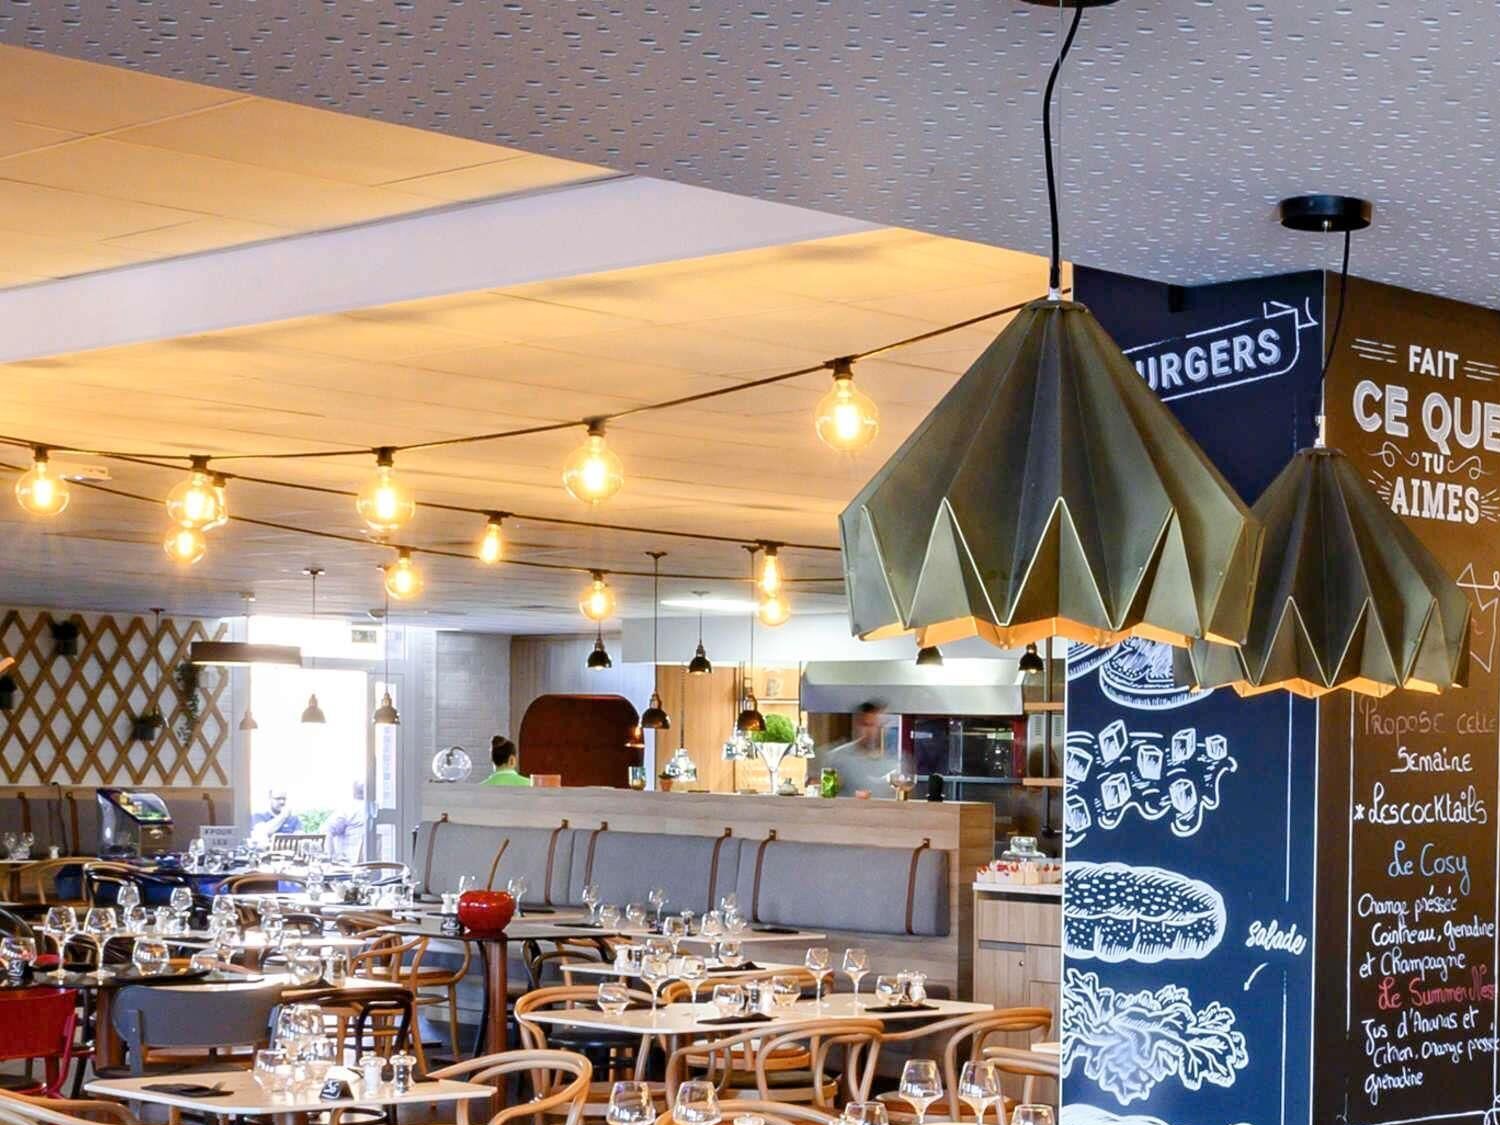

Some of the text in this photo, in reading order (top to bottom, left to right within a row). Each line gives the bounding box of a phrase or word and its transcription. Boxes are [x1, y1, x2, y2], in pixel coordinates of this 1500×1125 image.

[1136, 328, 1281, 391] URGERS
[1409, 344, 1459, 380] FAIT
[1353, 380, 1409, 437] CE
[1422, 452, 1444, 474] TU
[1391, 476, 1480, 525] AIMES
[1388, 840, 1470, 896] Le Cosy
[1358, 893, 1409, 929] Orange
[1245, 919, 1307, 955] Salade
[1359, 946, 1466, 982] et Champagne
[1378, 976, 1402, 1010] Le
[1361, 1018, 1388, 1056] Jus
[1463, 1004, 1479, 1029] et
